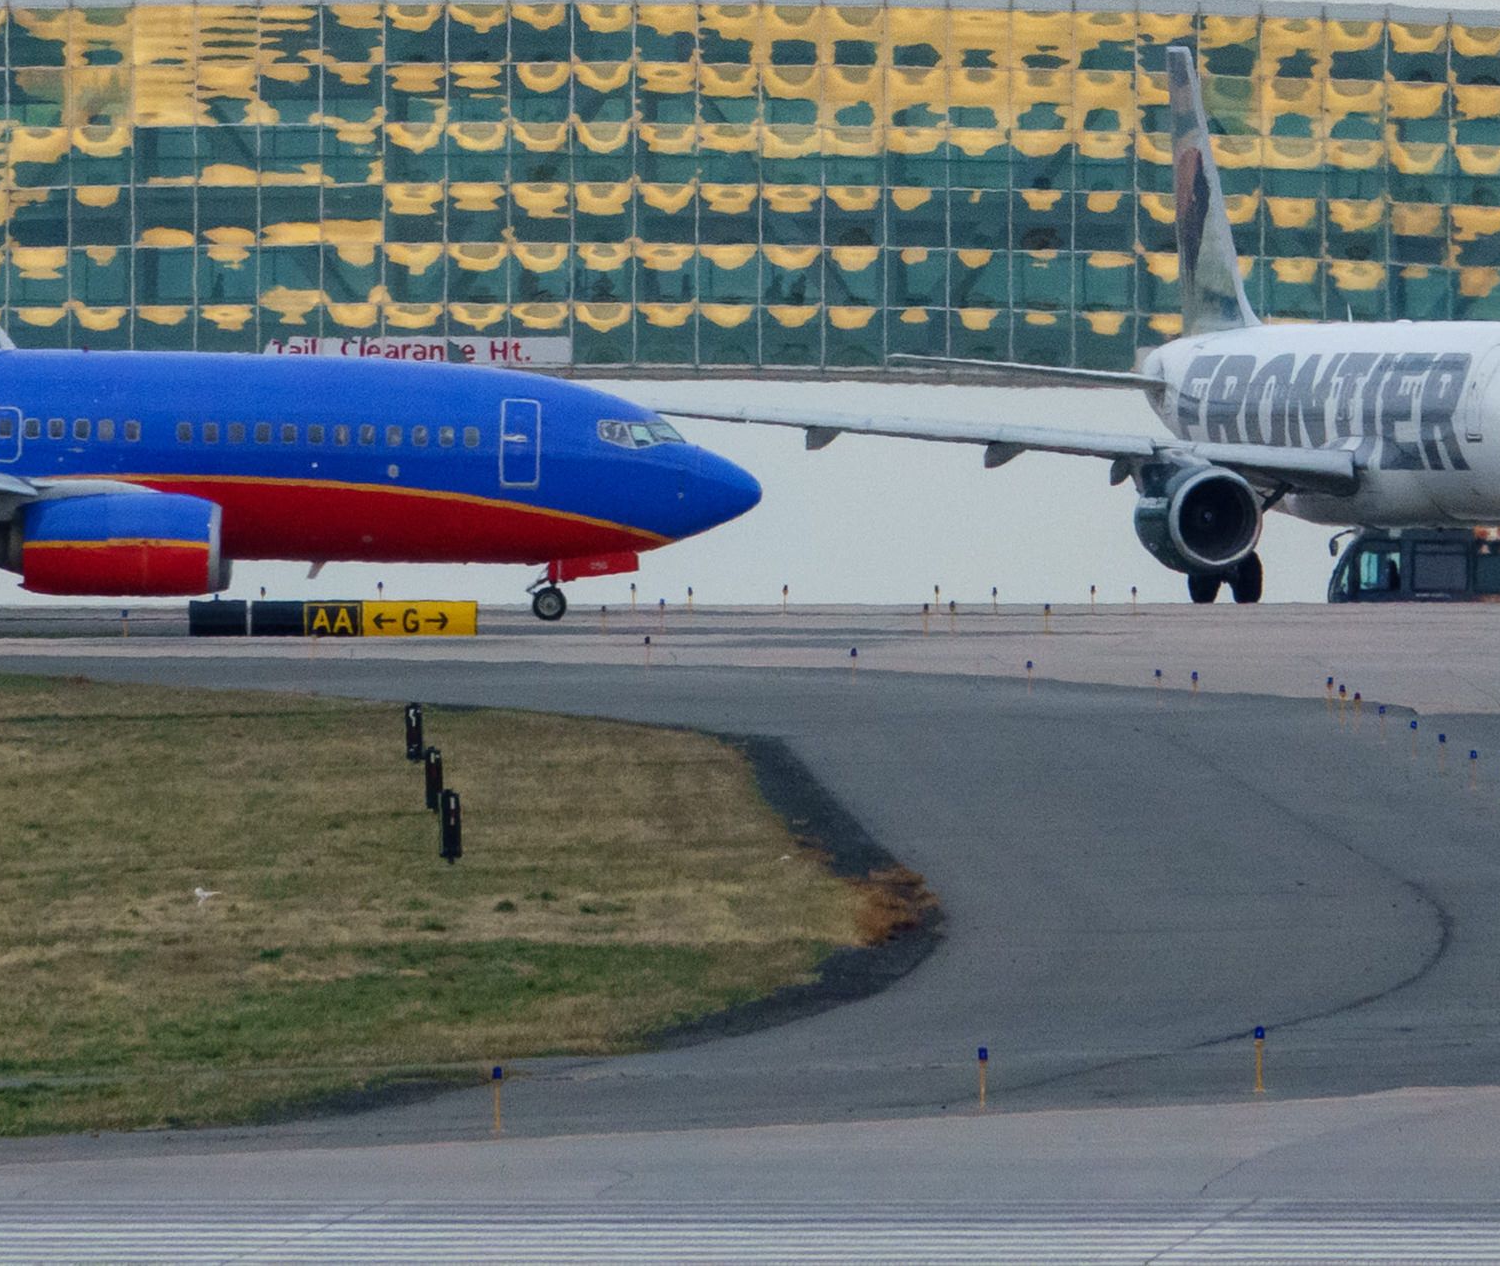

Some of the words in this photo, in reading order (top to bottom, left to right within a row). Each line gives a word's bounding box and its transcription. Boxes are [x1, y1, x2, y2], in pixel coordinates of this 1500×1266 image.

[340, 338, 476, 362] Clearane
[490, 340, 531, 362] Ht.
[1177, 352, 1472, 471] FRONTIER
[312, 607, 354, 634] AA
[402, 608, 420, 633] G
